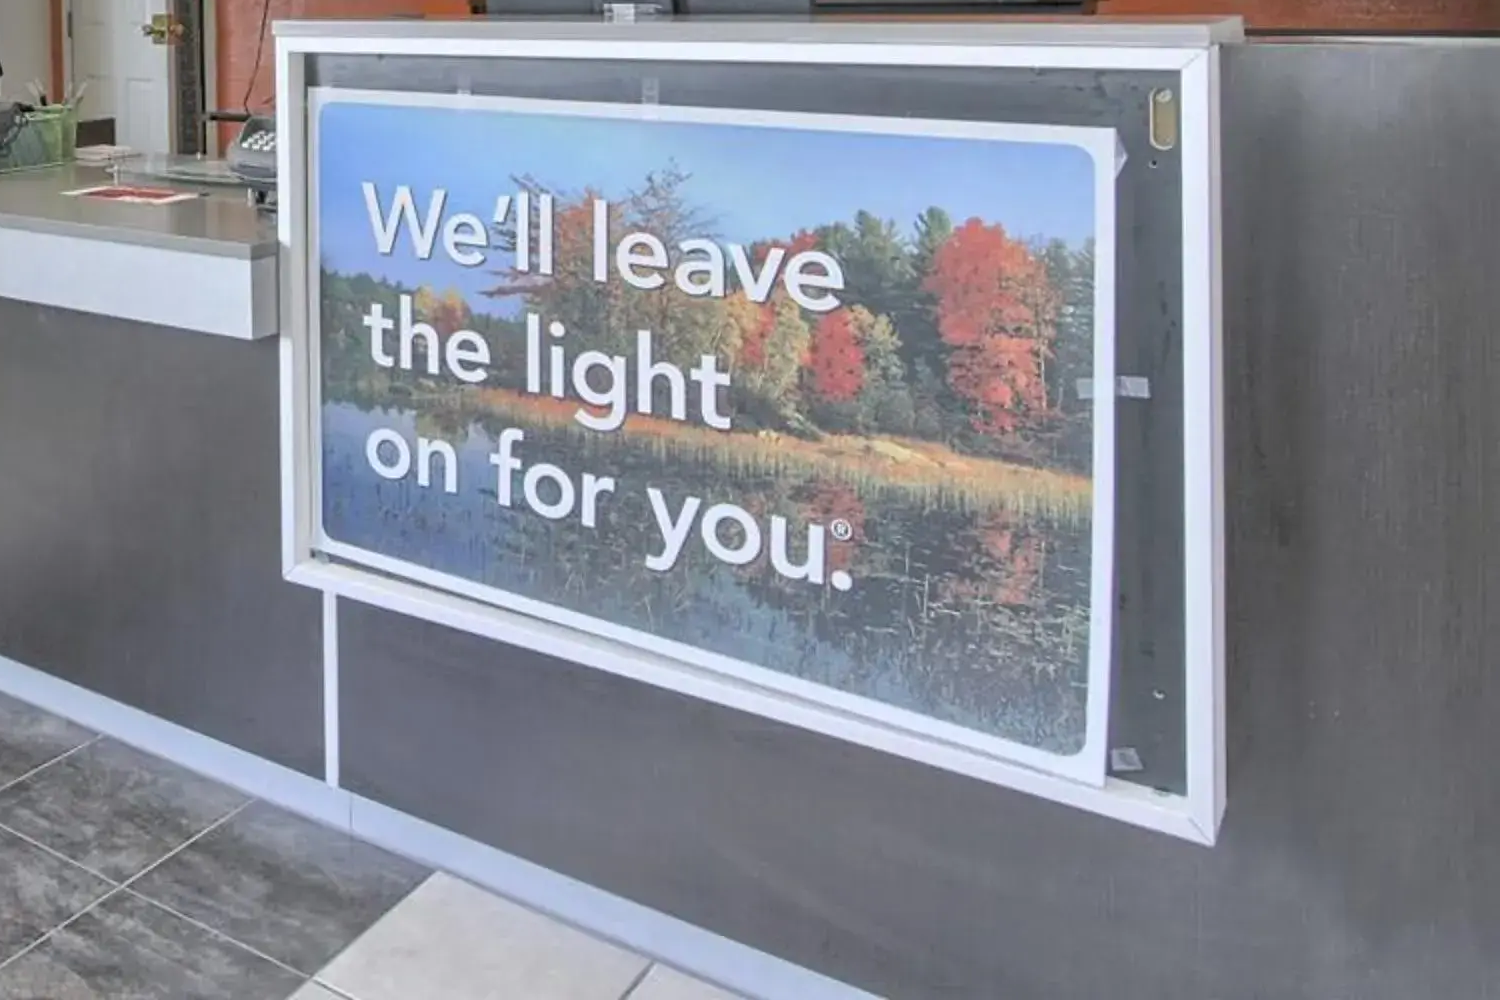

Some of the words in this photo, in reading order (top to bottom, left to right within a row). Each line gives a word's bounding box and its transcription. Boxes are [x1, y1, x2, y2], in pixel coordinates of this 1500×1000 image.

[362, 181, 554, 275] We'll
[593, 199, 845, 312] leave
[363, 294, 491, 383] the
[527, 313, 731, 431] light
[366, 428, 457, 494] on
[490, 427, 615, 528] for
